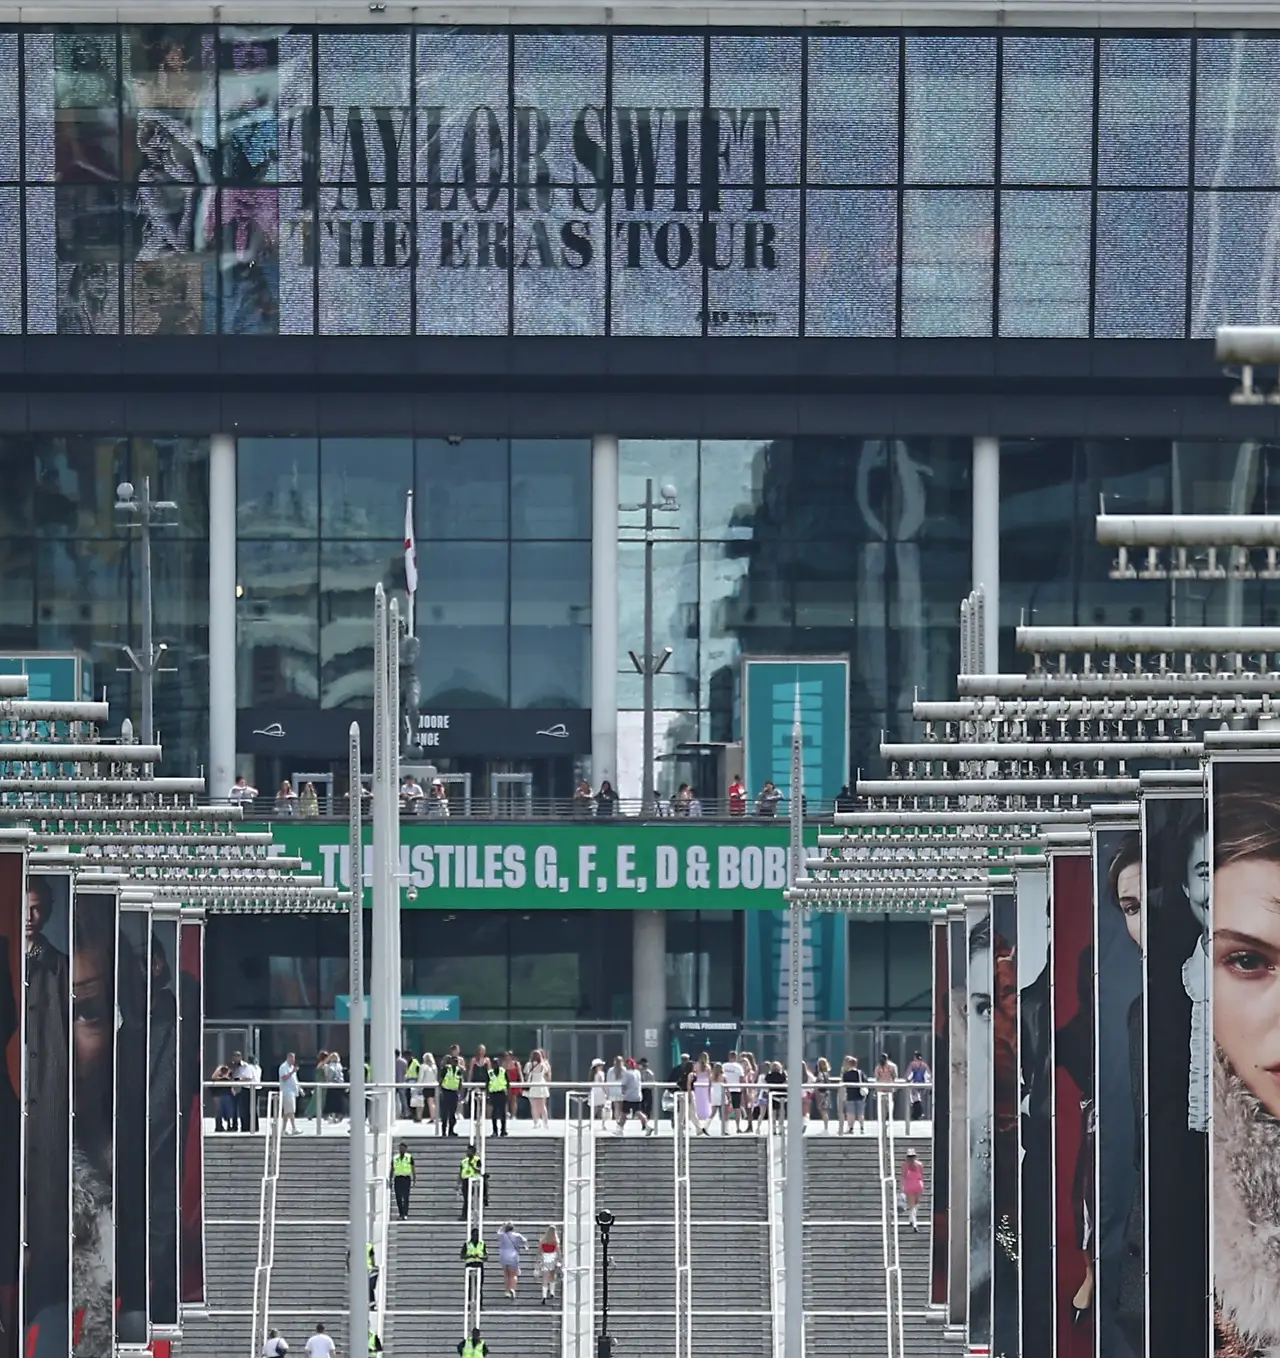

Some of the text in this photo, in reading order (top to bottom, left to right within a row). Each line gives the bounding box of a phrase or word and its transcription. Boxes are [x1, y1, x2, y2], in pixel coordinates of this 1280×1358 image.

[287, 105, 780, 213] TAYLOR SWIFT
[290, 220, 778, 270] THE ERAS TOUR
[534, 844, 570, 893] G,
[578, 845, 607, 893] F,
[616, 845, 649, 893] E,
[655, 845, 678, 888] D
[685, 845, 710, 889] &
